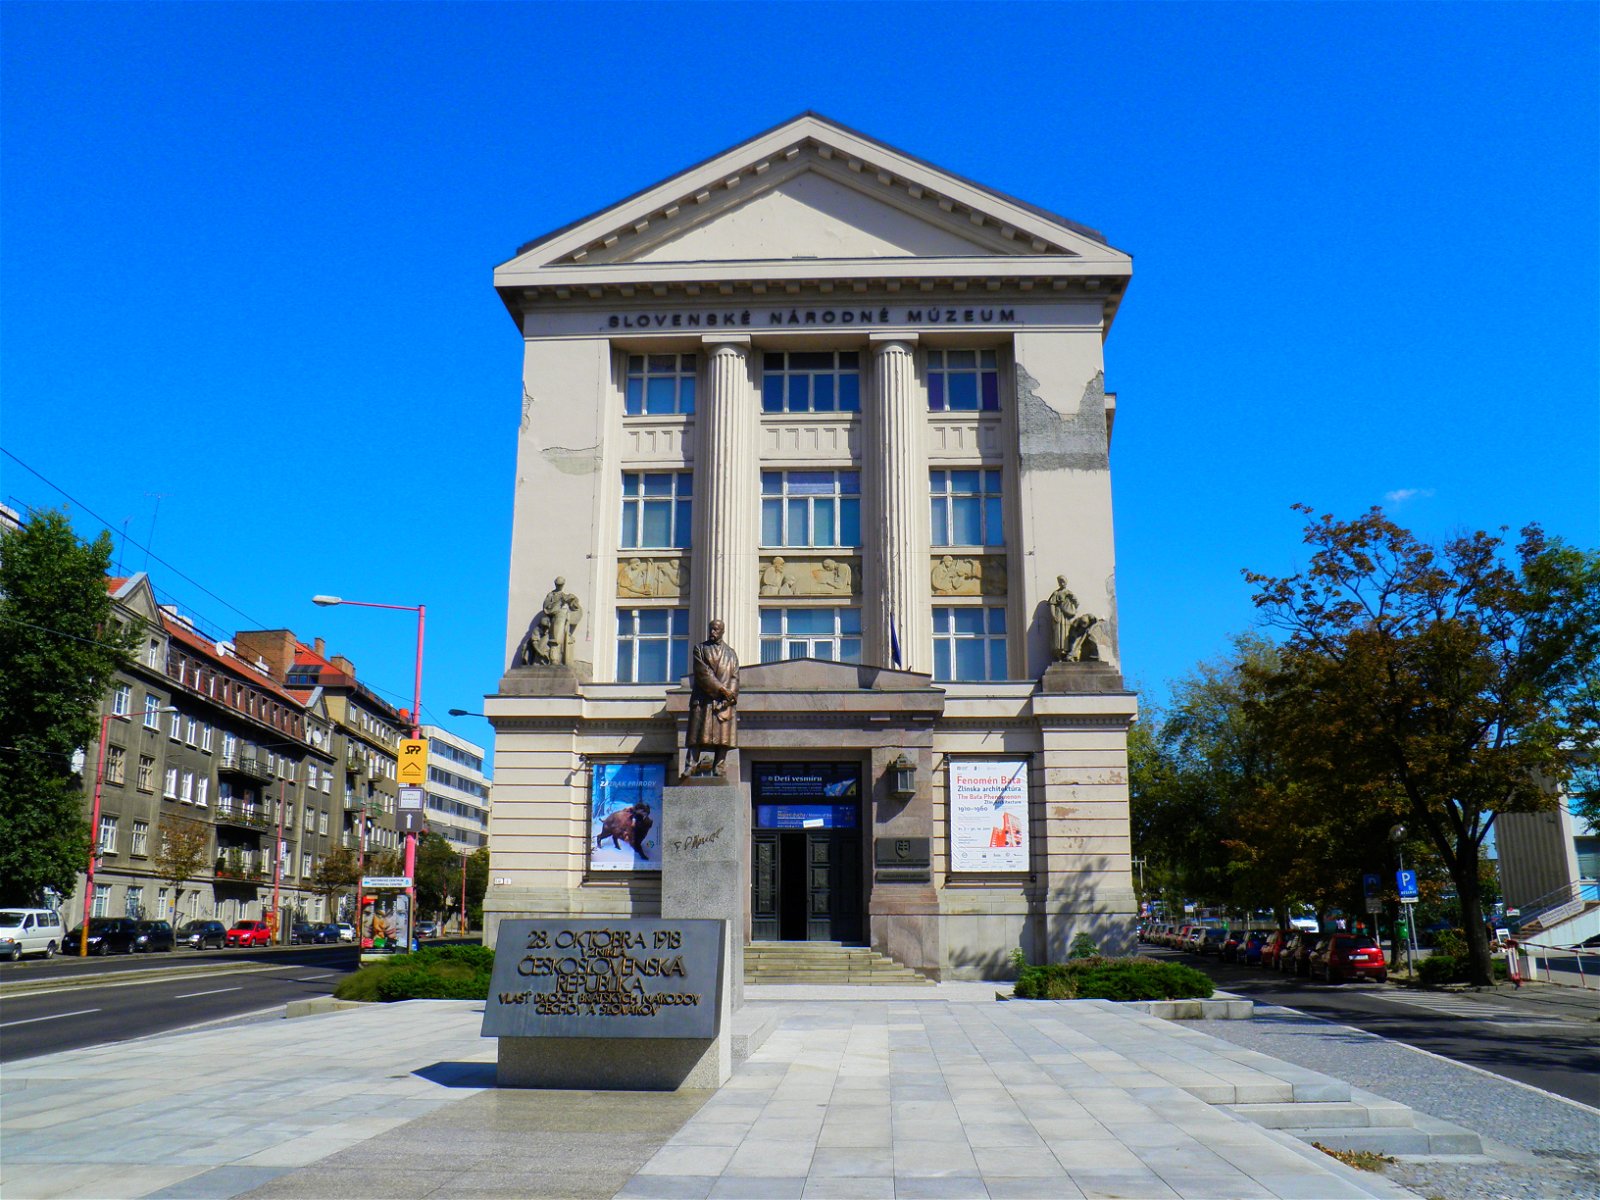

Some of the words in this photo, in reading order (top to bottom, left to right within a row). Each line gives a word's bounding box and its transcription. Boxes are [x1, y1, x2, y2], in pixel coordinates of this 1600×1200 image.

[608, 309, 752, 328] SLOVENSKÉ
[770, 307, 891, 325] NÁRODNÉ
[907, 306, 1017, 324] MÚZEUM
[405, 745, 421, 755] SPP
[774, 775, 790, 783] Deti
[957, 776, 998, 785] Fenomén
[1402, 872, 1411, 887] P
[526, 930, 552, 949] 28.
[555, 928, 647, 949] OKTÓBRA
[652, 929, 682, 949] 1918
[581, 947, 627, 958] VZNIKLA
[518, 954, 686, 977] ČESKOSLOVENSKÁ
[556, 974, 645, 994] REPUBLIKA
[534, 992, 574, 1004] DVOCH
[588, 1004, 596, 1015] A
